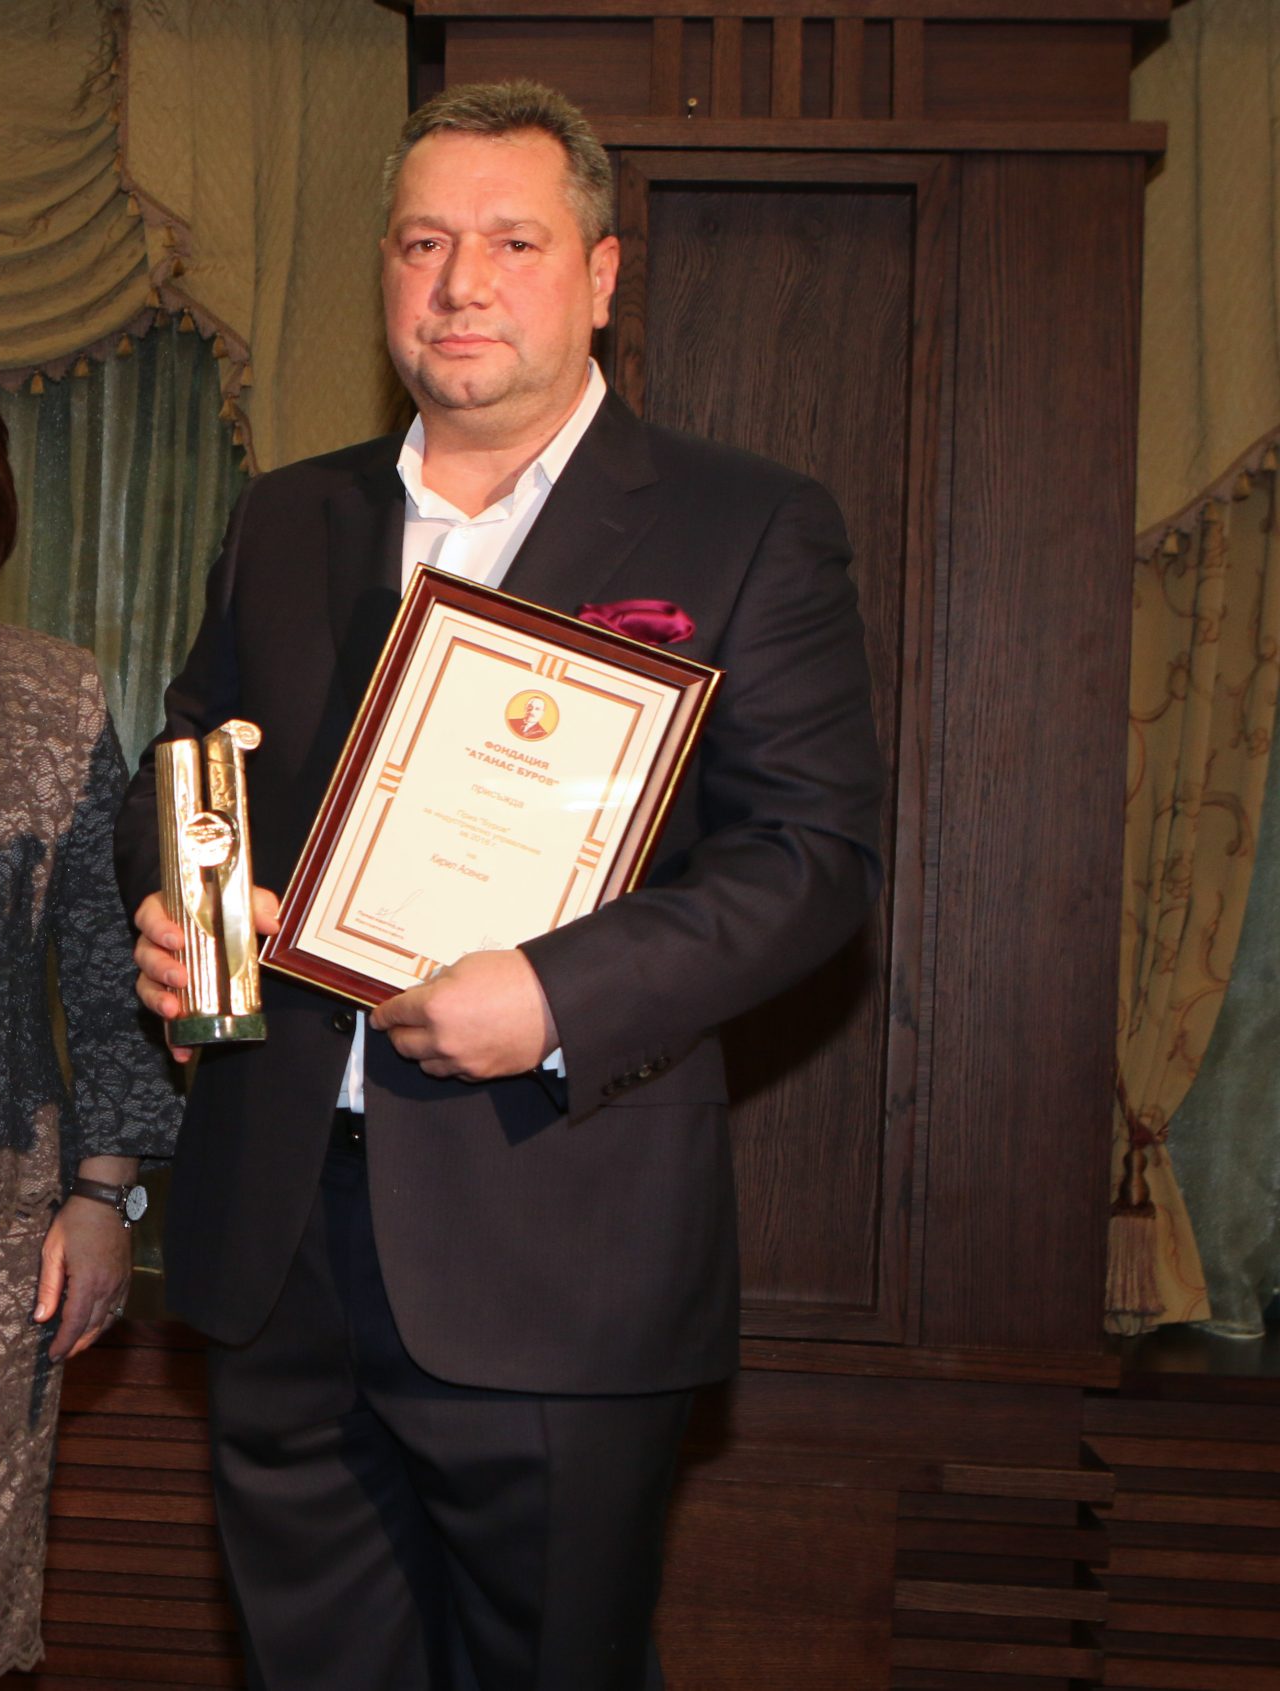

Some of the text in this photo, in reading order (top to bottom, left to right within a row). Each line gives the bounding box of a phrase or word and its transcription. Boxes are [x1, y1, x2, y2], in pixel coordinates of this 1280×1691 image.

[465, 747, 560, 787] "АТАНАС БУРОВ"
[484, 741, 549, 770] ФОНДАЦИЯ
[471, 783, 524, 808] присъжда
